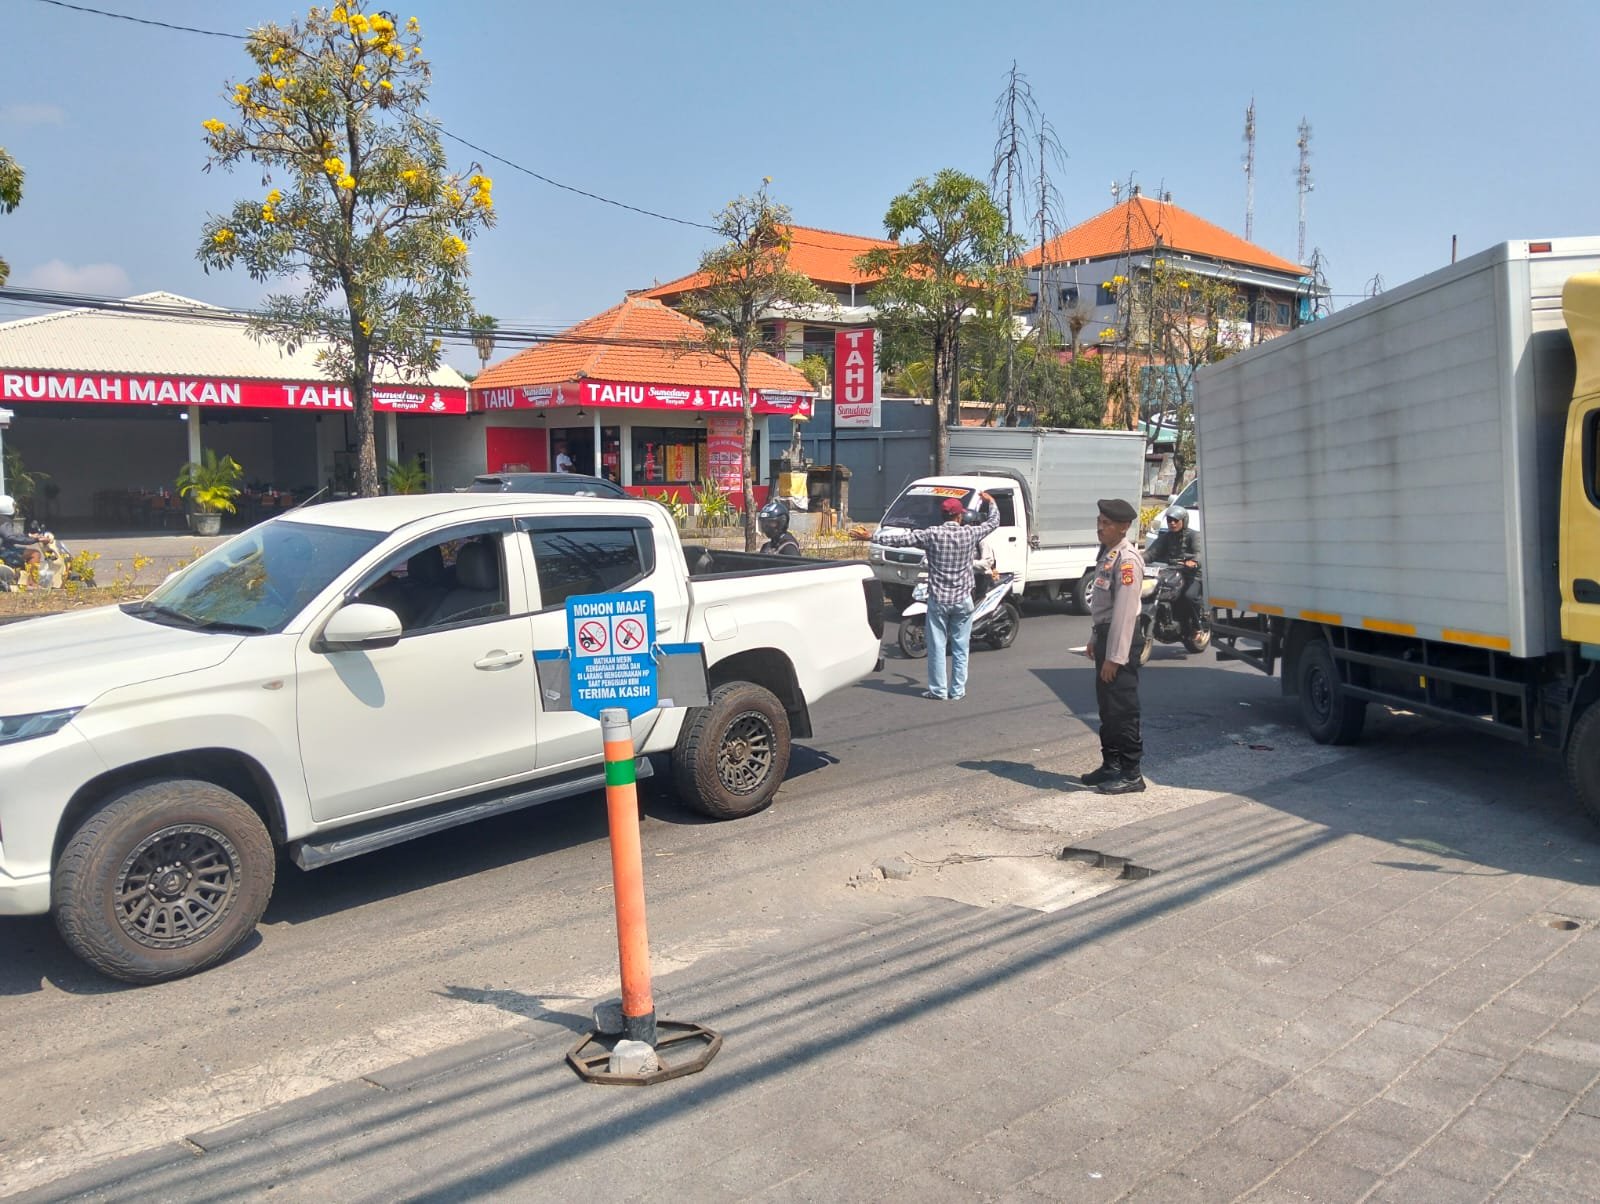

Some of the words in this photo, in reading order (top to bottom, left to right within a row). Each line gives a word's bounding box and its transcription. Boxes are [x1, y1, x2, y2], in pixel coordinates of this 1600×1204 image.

[845, 332, 864, 402] TAHU
[3, 374, 122, 400] RUMAH
[129, 379, 240, 404] MAKAN
[483, 388, 515, 408] TAHU
[587, 384, 644, 404] TAHU
[573, 604, 614, 617] MOHON
[616, 600, 647, 614] MAAF
[578, 687, 617, 699] TERIMA
[619, 685, 651, 698] KASIH
